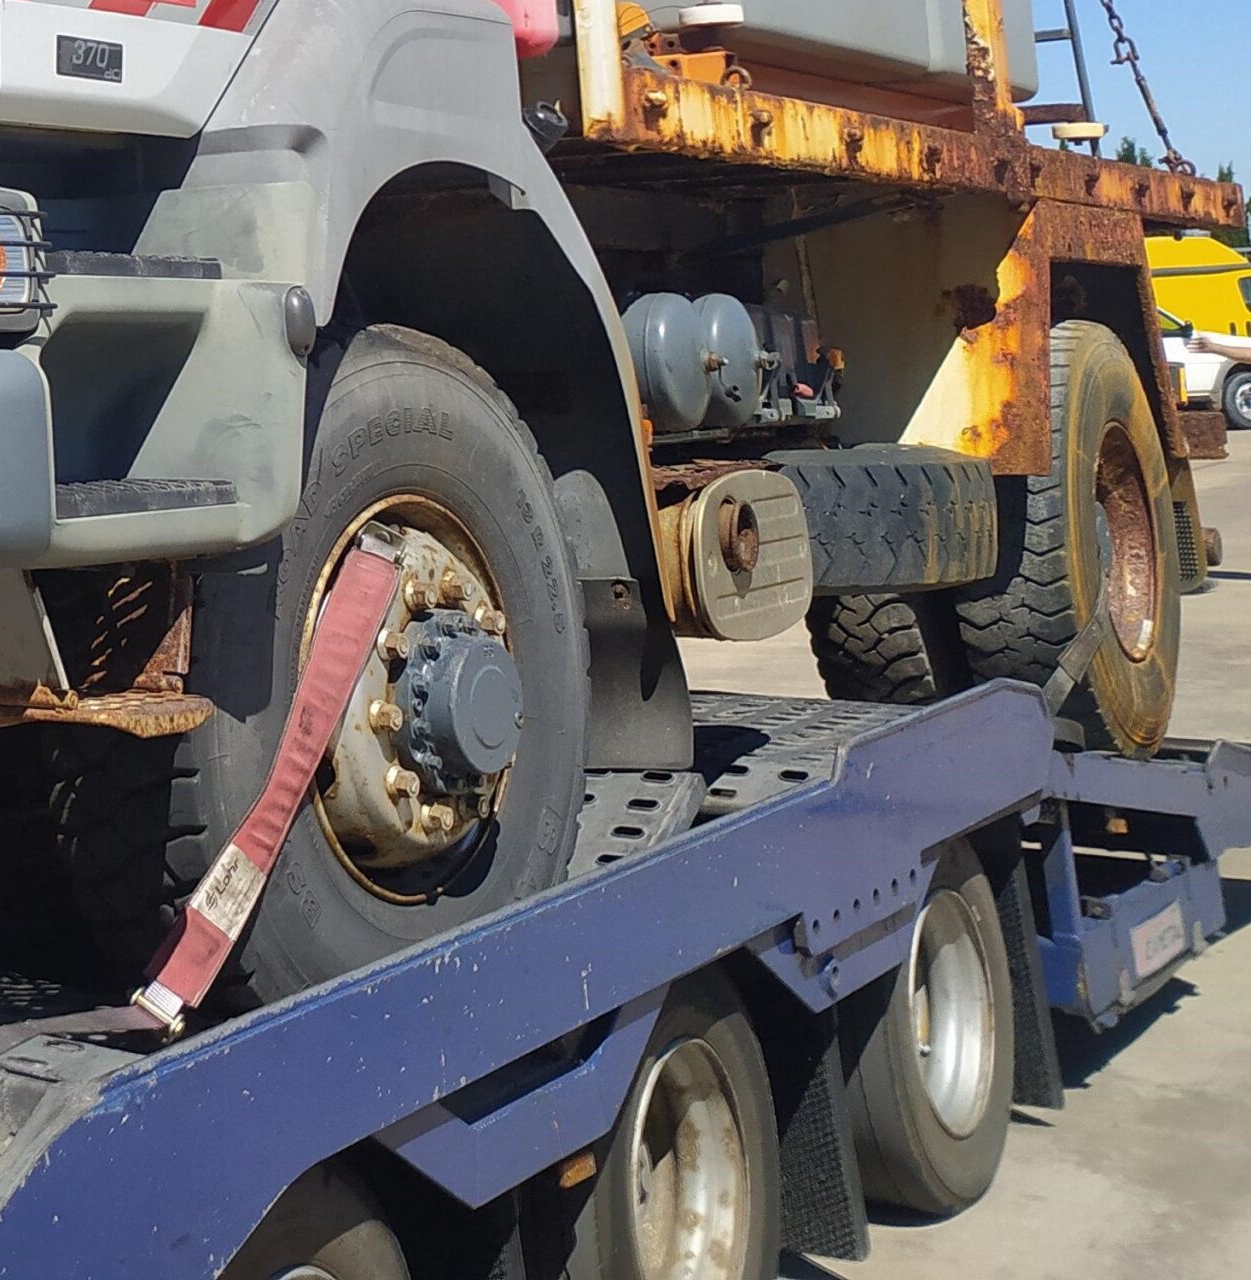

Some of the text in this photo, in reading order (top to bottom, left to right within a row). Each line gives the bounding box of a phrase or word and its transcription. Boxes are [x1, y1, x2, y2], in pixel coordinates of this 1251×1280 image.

[72, 39, 109, 69] 370
[331, 406, 454, 478] SPECIAL
[214, 857, 240, 895] Lohr
